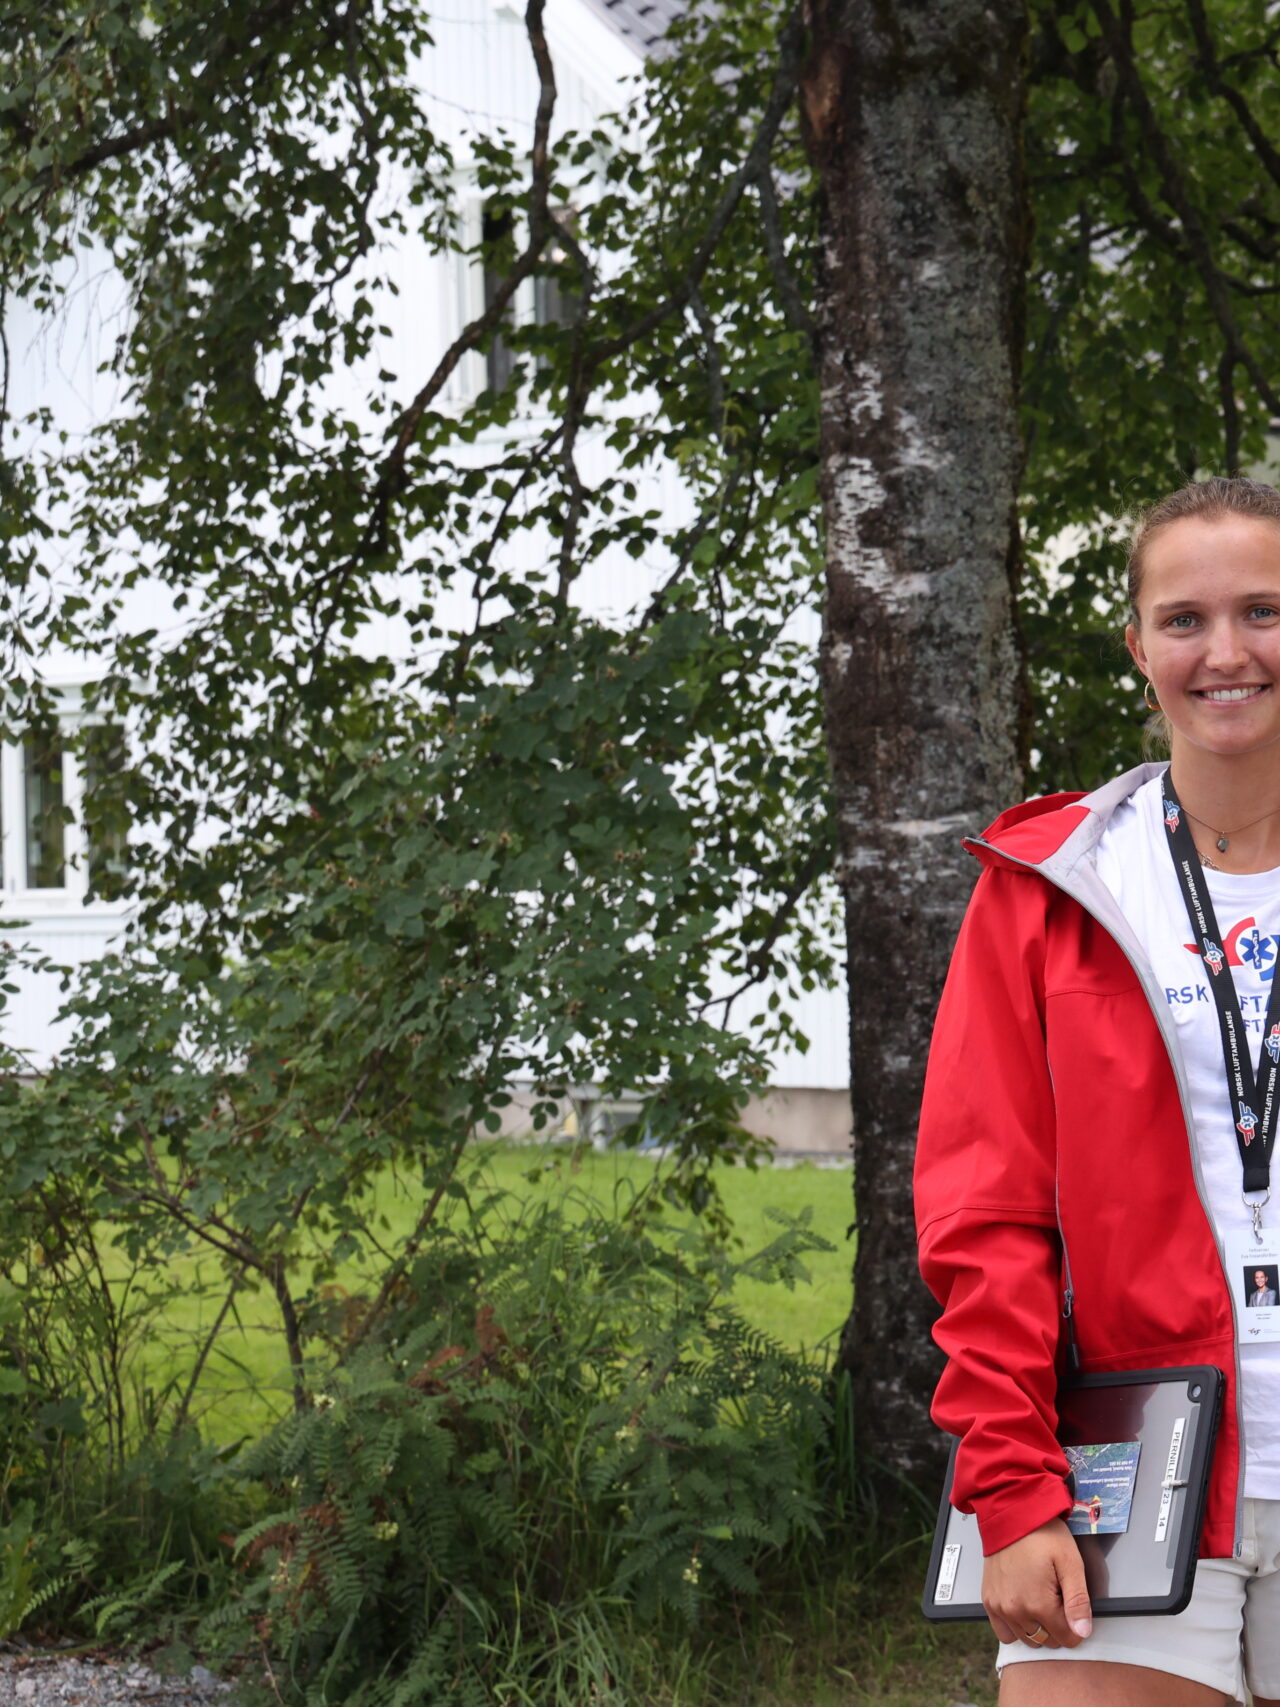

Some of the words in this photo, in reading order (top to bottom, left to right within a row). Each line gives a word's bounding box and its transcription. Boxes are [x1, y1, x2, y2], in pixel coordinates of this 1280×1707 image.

[1181, 859, 1203, 912] LUFTAMBULANSE
[1197, 913, 1208, 934] NORSK
[1164, 984, 1209, 1005] RSK
[1224, 1010, 1241, 1072] LUFTAMBULANSE
[1234, 1071, 1245, 1097] NORSK
[1268, 1067, 1277, 1093] NORSK
[1167, 1431, 1181, 1480] PERNILLE
[1162, 1493, 1170, 1504] 23
[1158, 1517, 1166, 1527] 14
